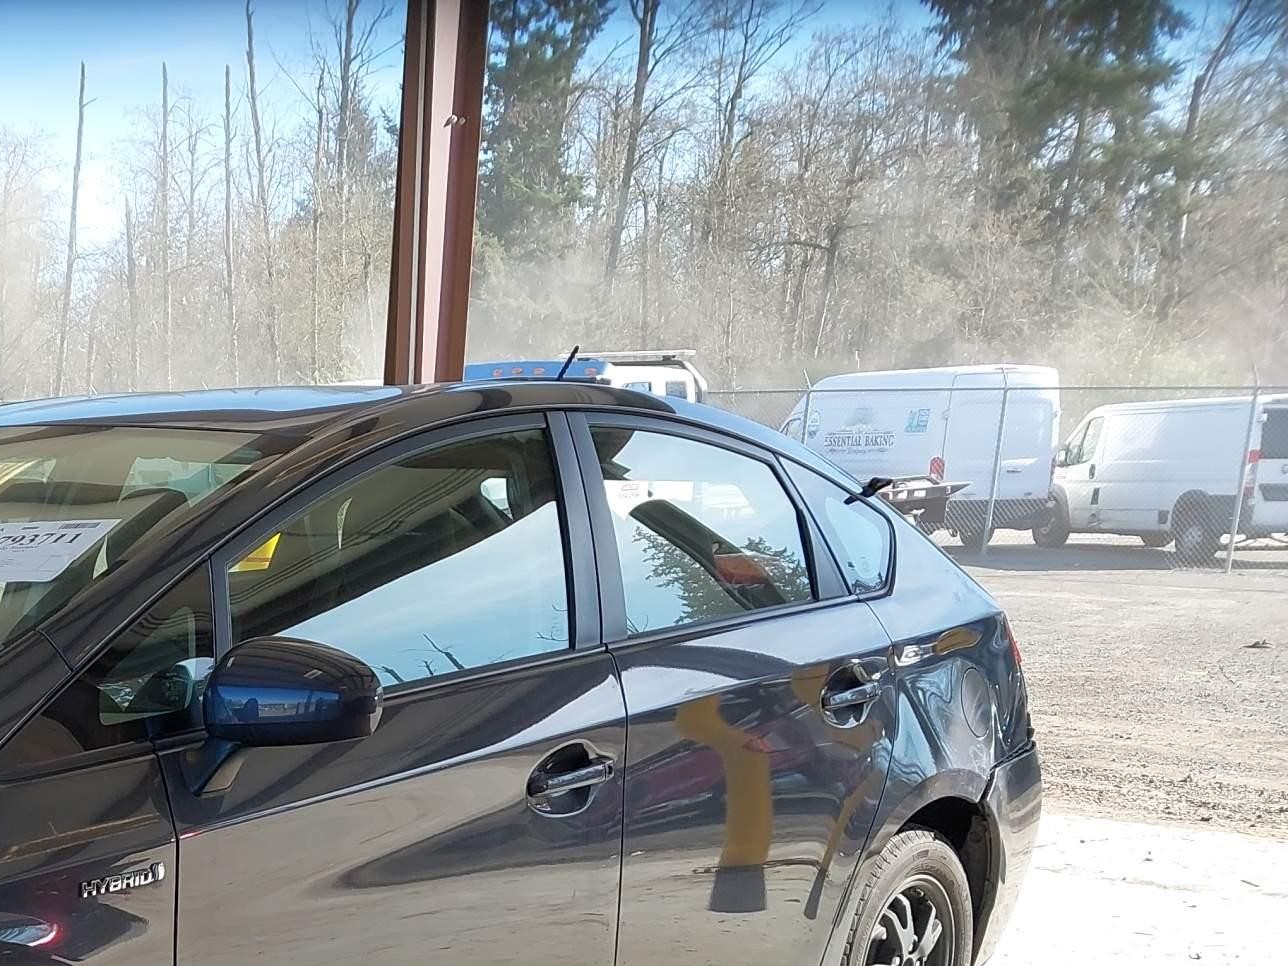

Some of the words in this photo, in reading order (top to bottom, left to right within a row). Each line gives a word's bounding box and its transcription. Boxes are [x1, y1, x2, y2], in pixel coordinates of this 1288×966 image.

[824, 435, 862, 447] ESSENTIAL
[864, 434, 894, 447] BAKING
[81, 869, 153, 898] HYBRID
